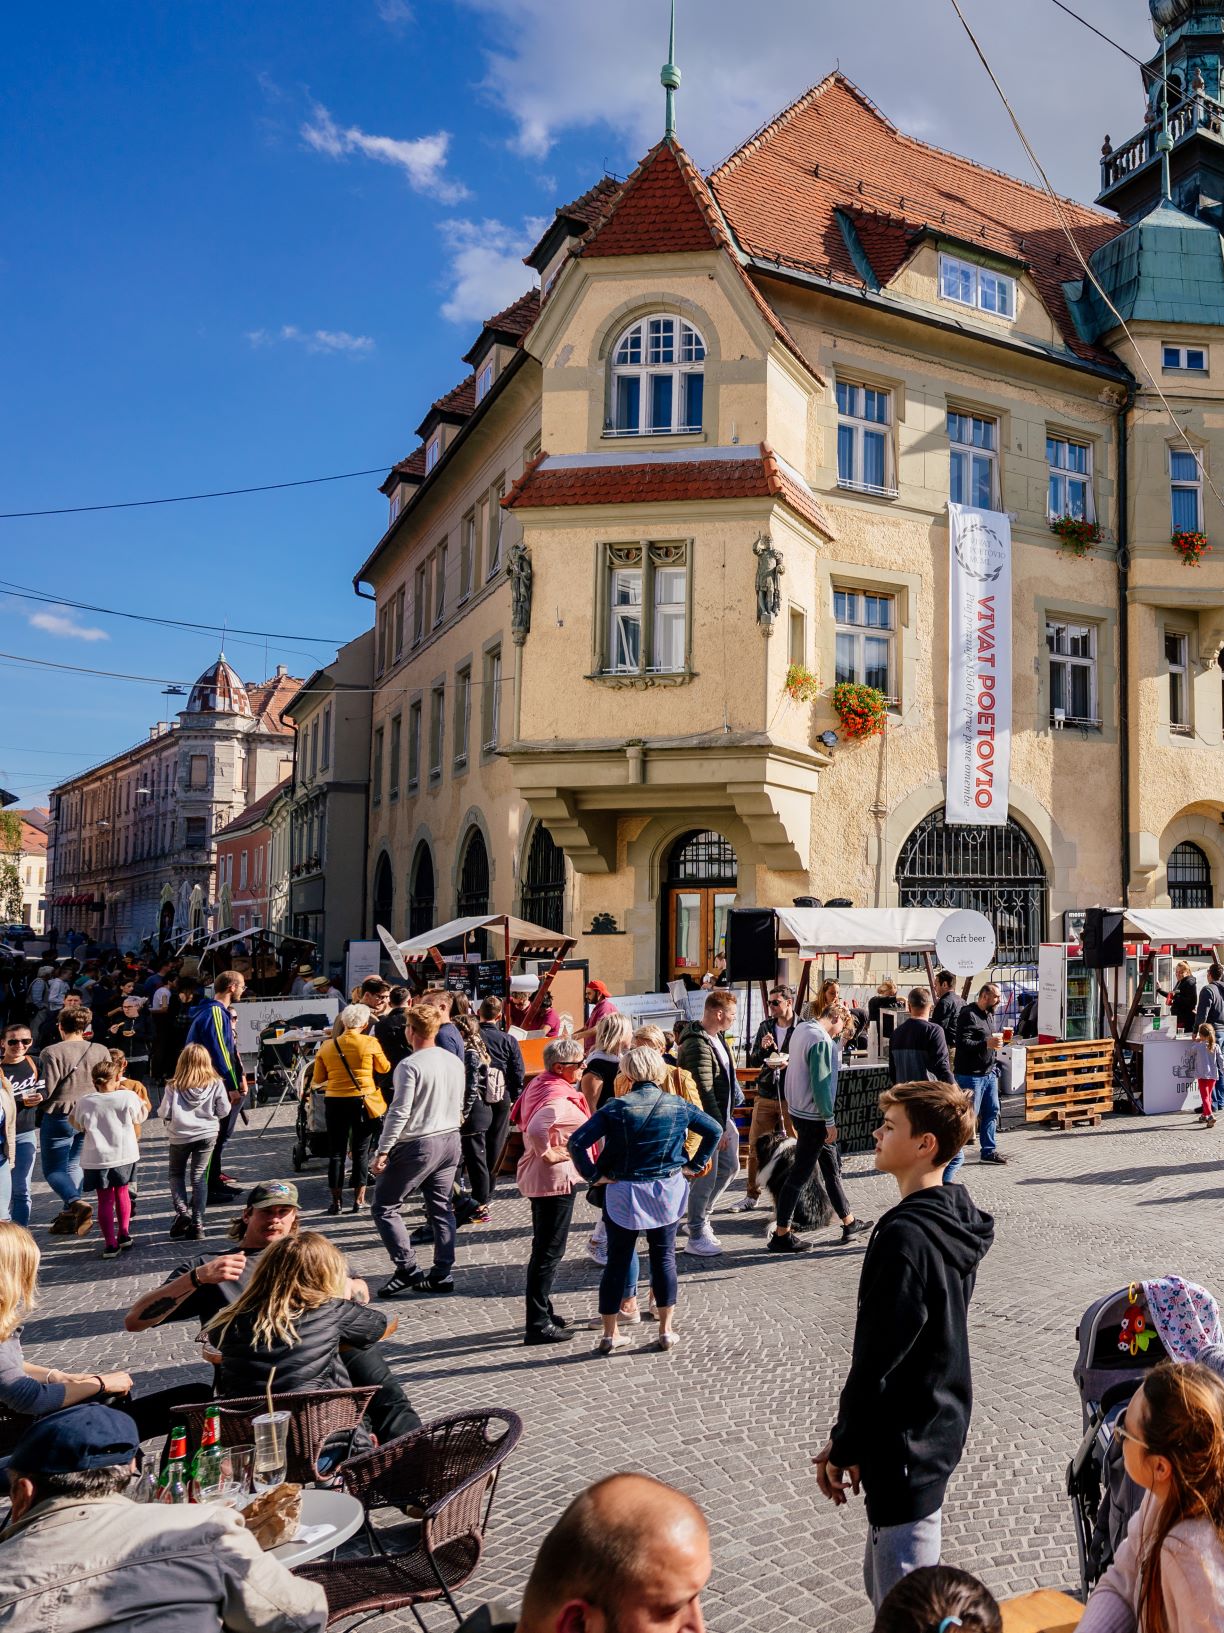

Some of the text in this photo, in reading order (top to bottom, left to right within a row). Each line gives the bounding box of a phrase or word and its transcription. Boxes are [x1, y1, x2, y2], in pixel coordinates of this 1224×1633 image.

[965, 665, 975, 690] 1950
[965, 693, 975, 706] let
[974, 595, 996, 809] VIVAT POETOVIO
[963, 708, 974, 733] prve
[963, 734, 974, 761] pisne
[963, 764, 974, 807] omembe
[945, 933, 987, 943] Craft beer
